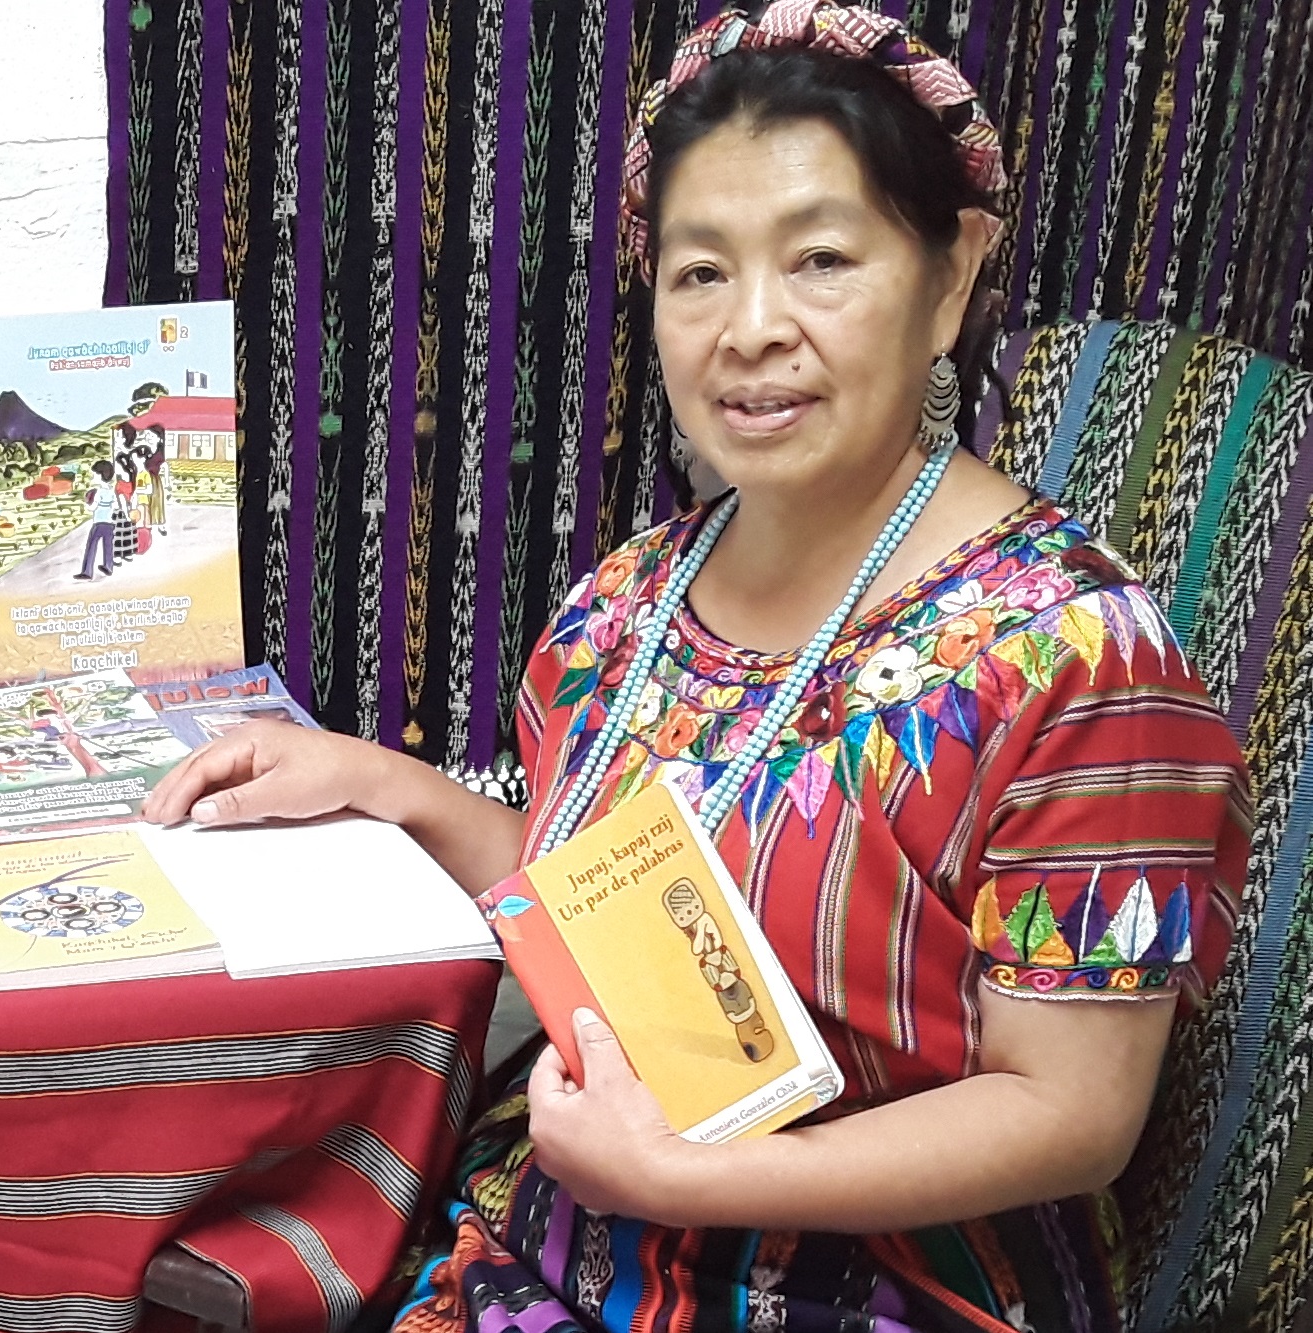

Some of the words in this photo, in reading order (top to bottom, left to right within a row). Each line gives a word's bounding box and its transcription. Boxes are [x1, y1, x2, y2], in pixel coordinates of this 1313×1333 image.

[72, 652, 137, 672] Kaqchikel
[557, 903, 584, 921] Un
[585, 886, 610, 913] par
[611, 875, 629, 892] de
[629, 839, 684, 885] palabras
[566, 857, 613, 893] Jupaj,
[610, 829, 651, 863] kapaj
